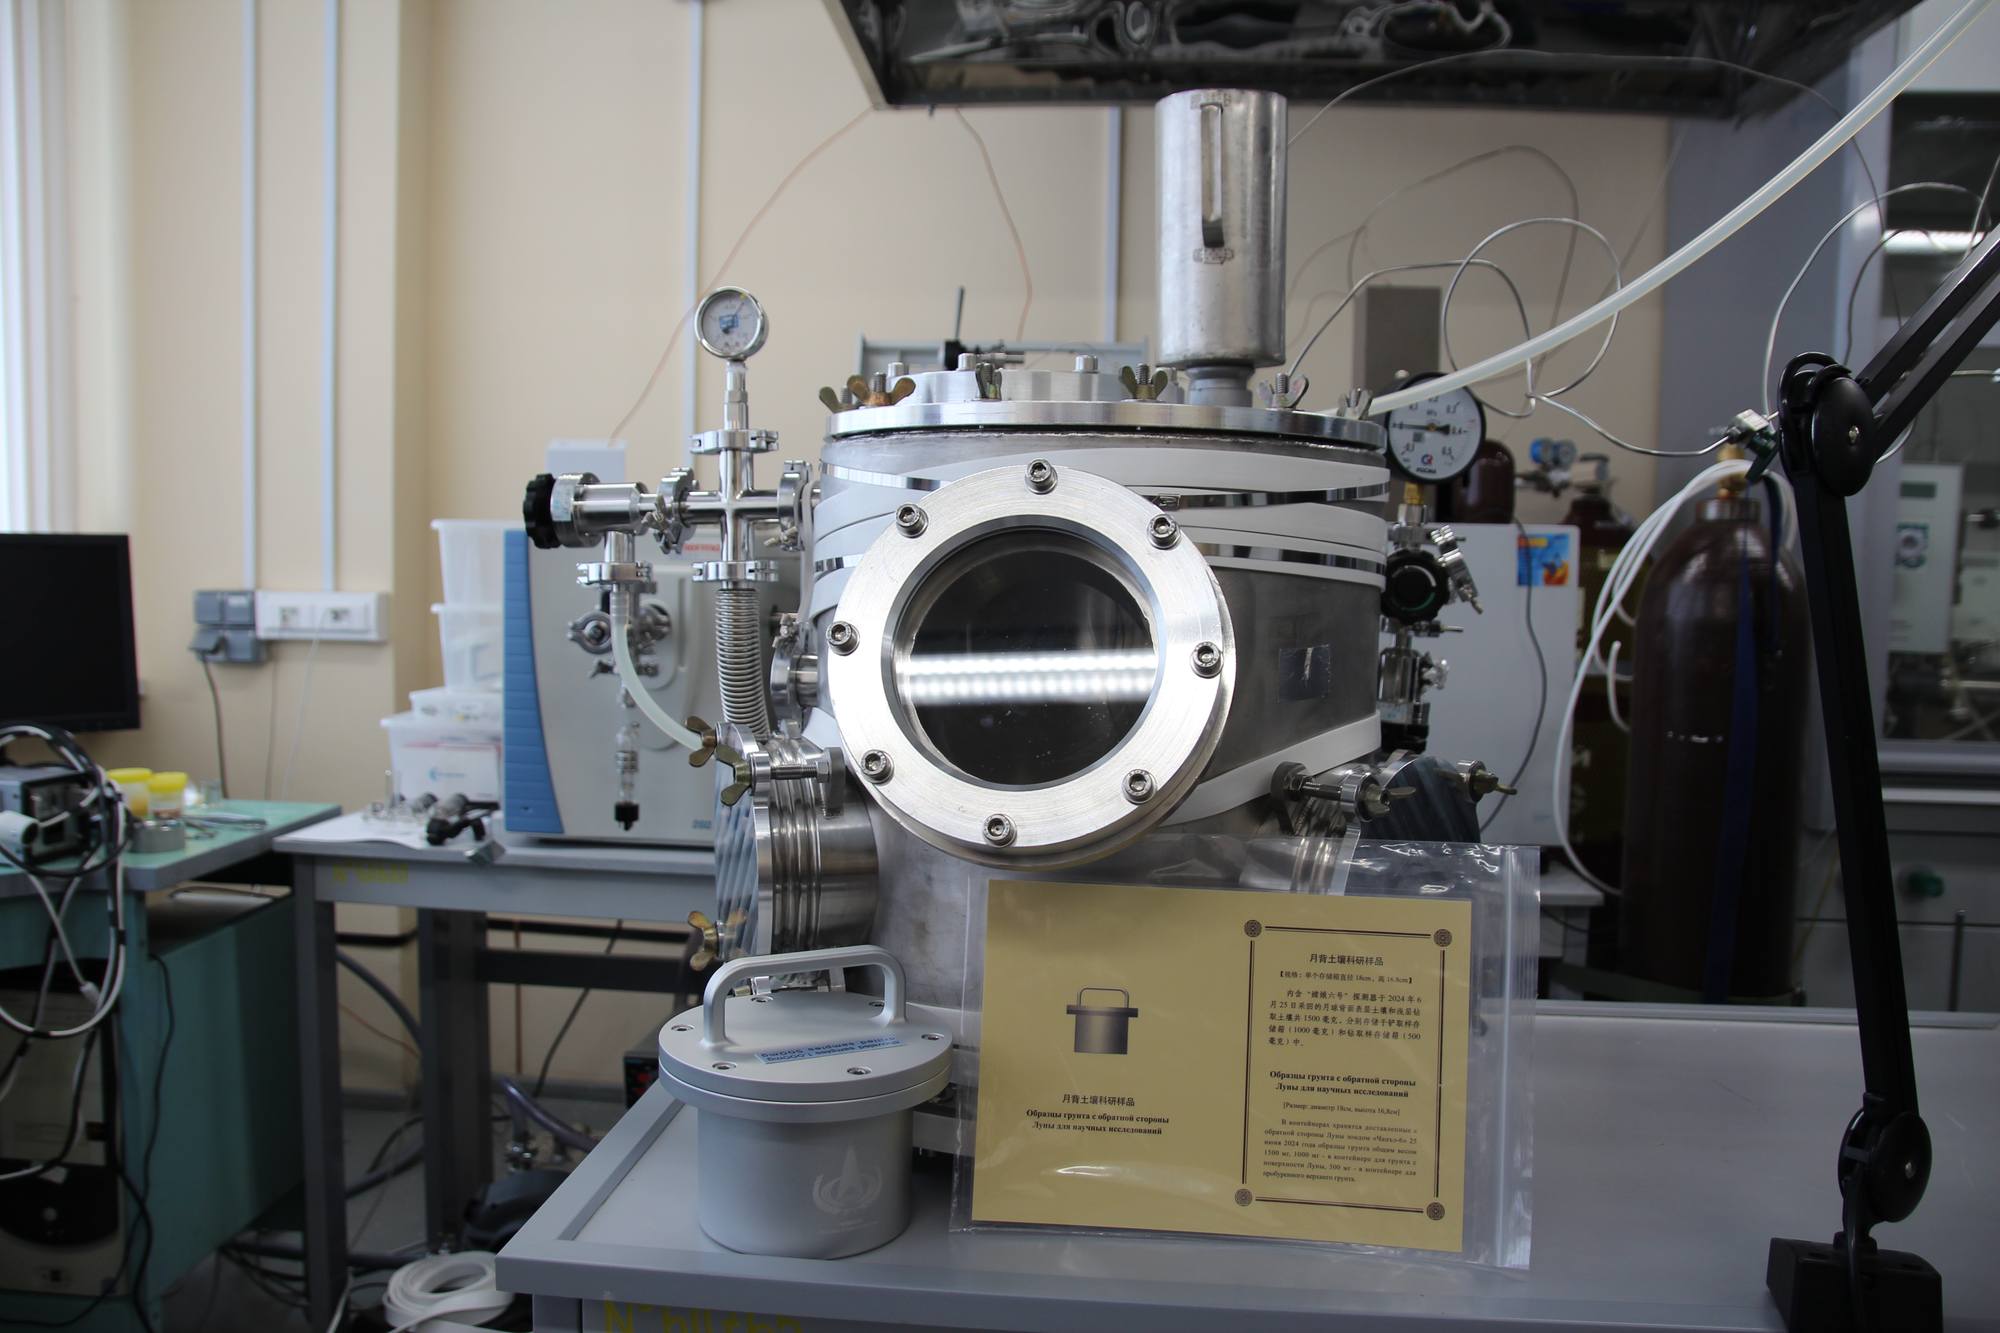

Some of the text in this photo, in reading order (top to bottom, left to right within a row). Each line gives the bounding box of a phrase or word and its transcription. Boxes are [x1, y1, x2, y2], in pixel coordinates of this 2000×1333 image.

[1310, 954, 1384, 966] 月背土壤科研样品
[1270, 1071, 1306, 1080] Образцы
[1308, 1073, 1335, 1082] грунта
[1342, 1075, 1380, 1085] обратной
[1382, 1079, 1416, 1087] стороны
[1275, 1083, 1298, 1091] Луны
[1317, 1086, 1351, 1095] научных
[1353, 1089, 1409, 1098] исследований
[1062, 1094, 1135, 1106] 月背土壤科研样品
[1026, 1109, 1062, 1118] Образцы
[1064, 1112, 1090, 1120] грунта
[1098, 1113, 1134, 1122] обратной
[1032, 1121, 1055, 1130] Луны
[1073, 1125, 1106, 1133] научных
[1108, 1127, 1162, 1135] исследований
